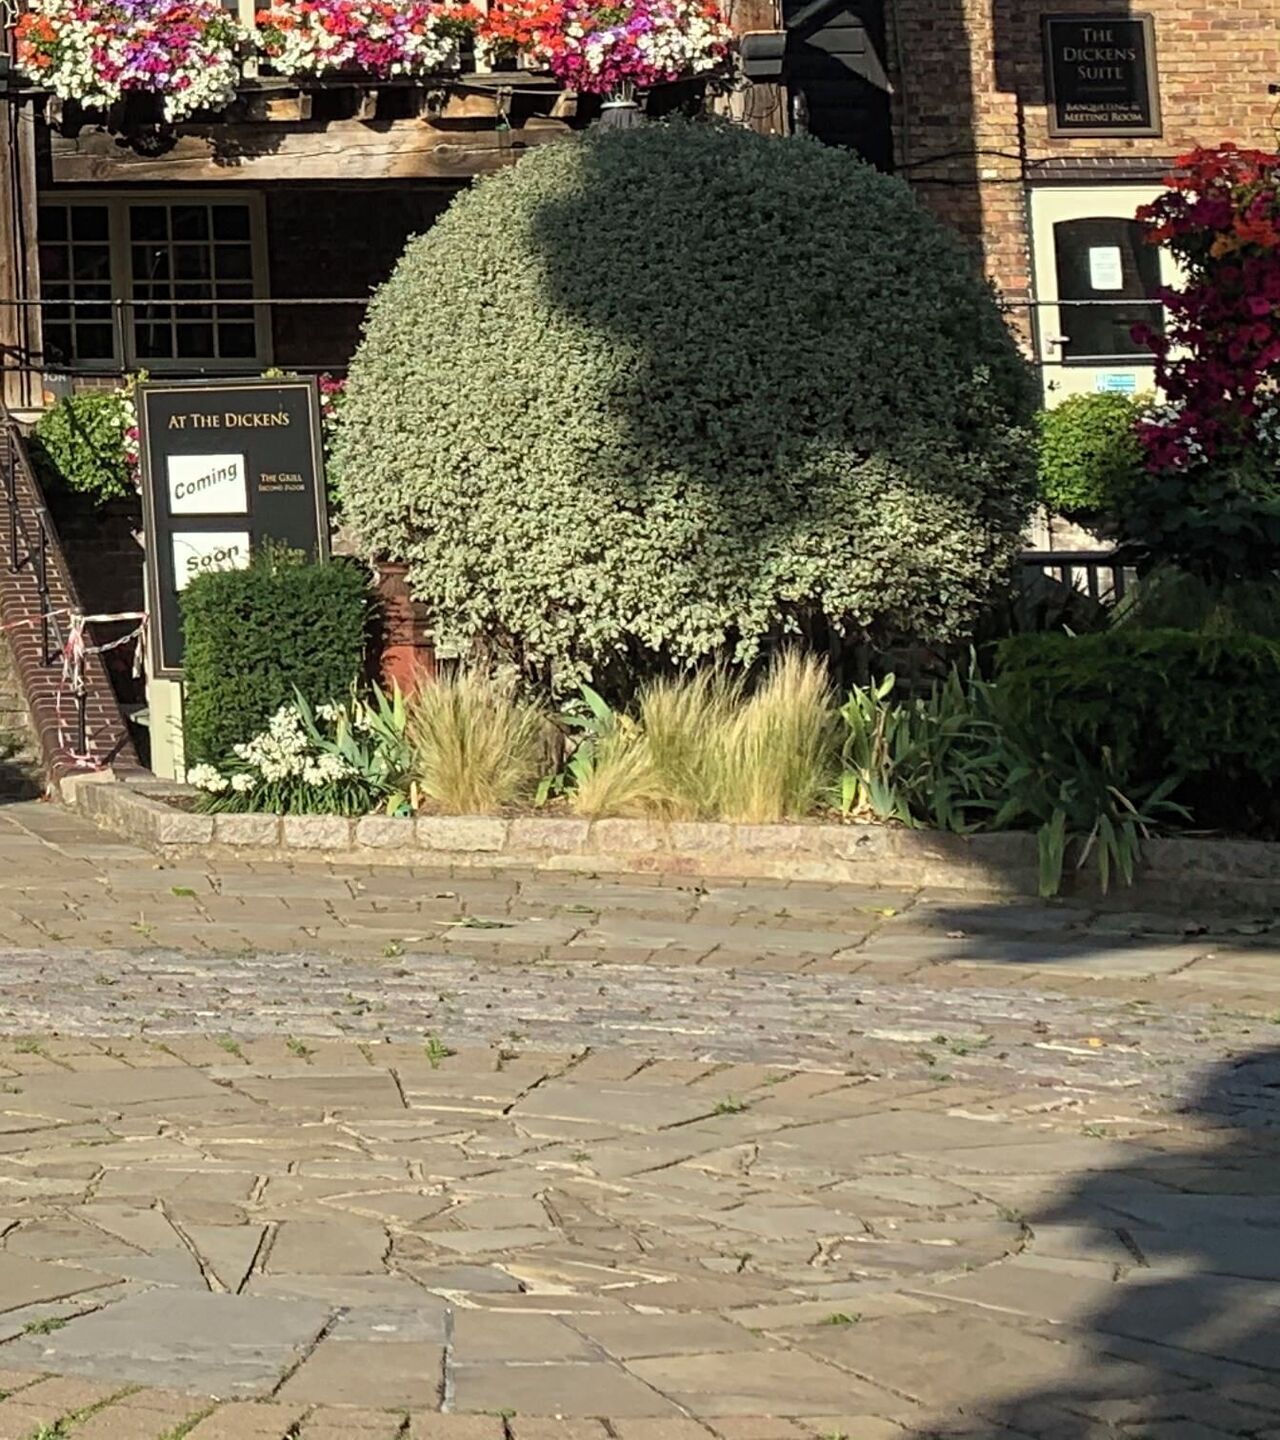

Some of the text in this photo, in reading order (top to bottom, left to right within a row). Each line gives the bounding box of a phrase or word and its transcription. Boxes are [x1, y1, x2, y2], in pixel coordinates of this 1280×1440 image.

[1081, 28, 1114, 43] THE
[1063, 47, 1137, 62] DICKENS
[1078, 66, 1124, 80] SUITE
[1064, 112, 1143, 122] MEETING ROOM
[168, 415, 187, 429] AT
[190, 414, 220, 428] THE
[174, 463, 238, 500] Coming
[187, 545, 240, 572] Soon
